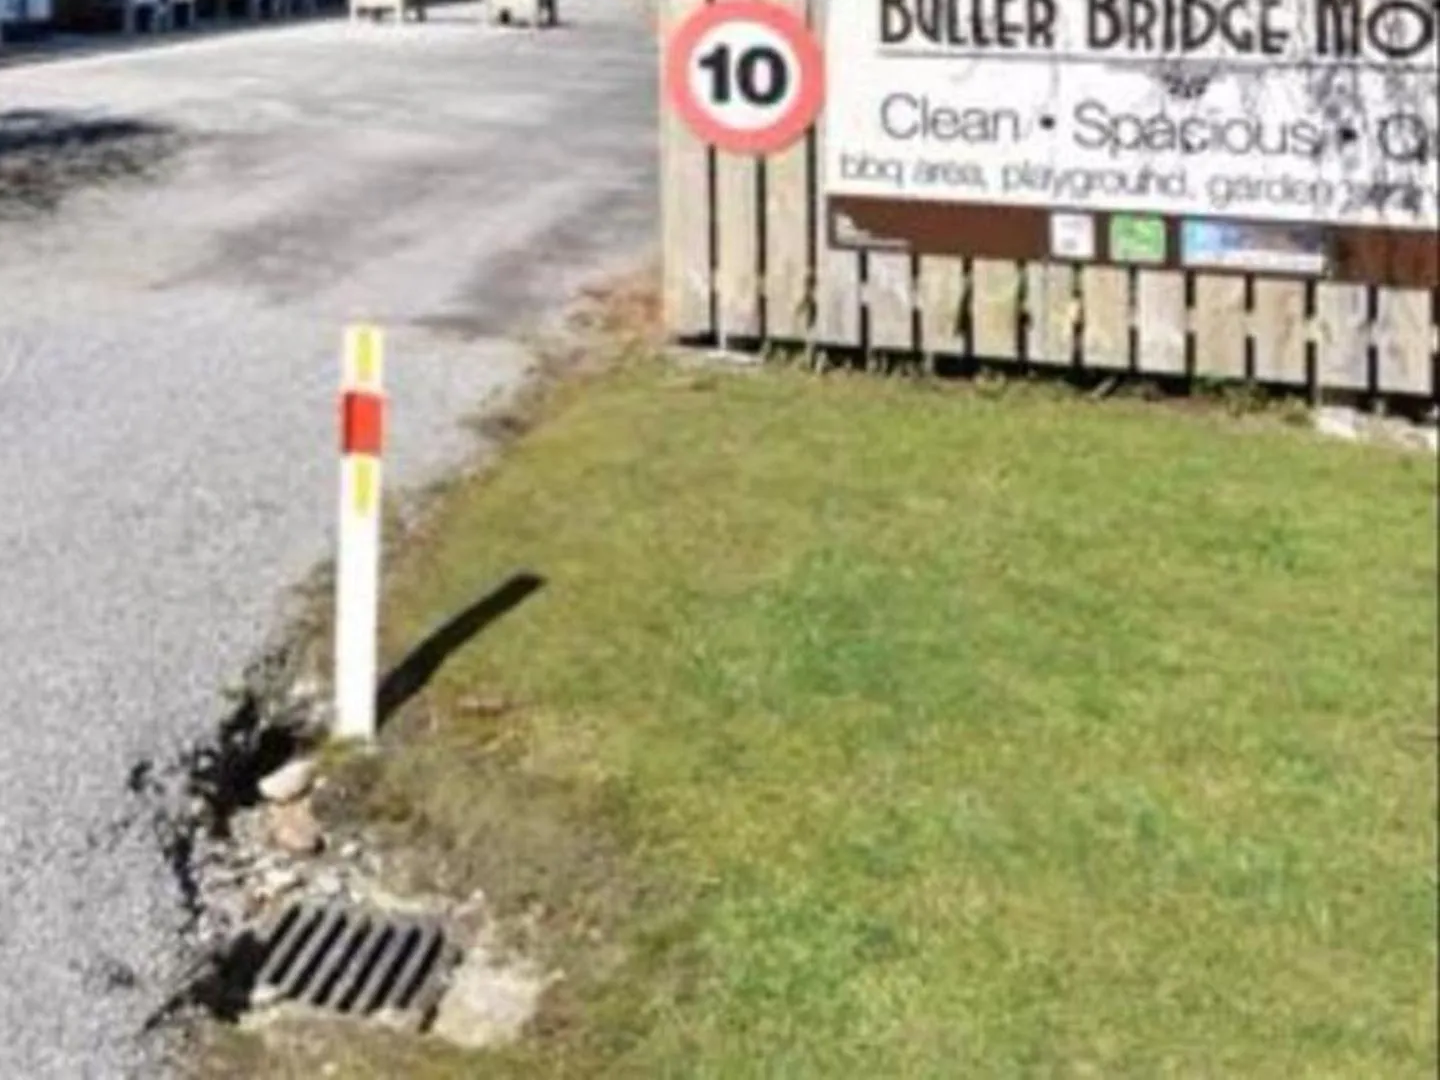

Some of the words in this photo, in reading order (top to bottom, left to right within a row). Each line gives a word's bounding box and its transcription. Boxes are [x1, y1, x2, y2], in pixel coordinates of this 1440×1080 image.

[698, 43, 789, 105] 10
[879, 91, 1021, 142] Clean
[1072, 98, 1322, 159] Spacious
